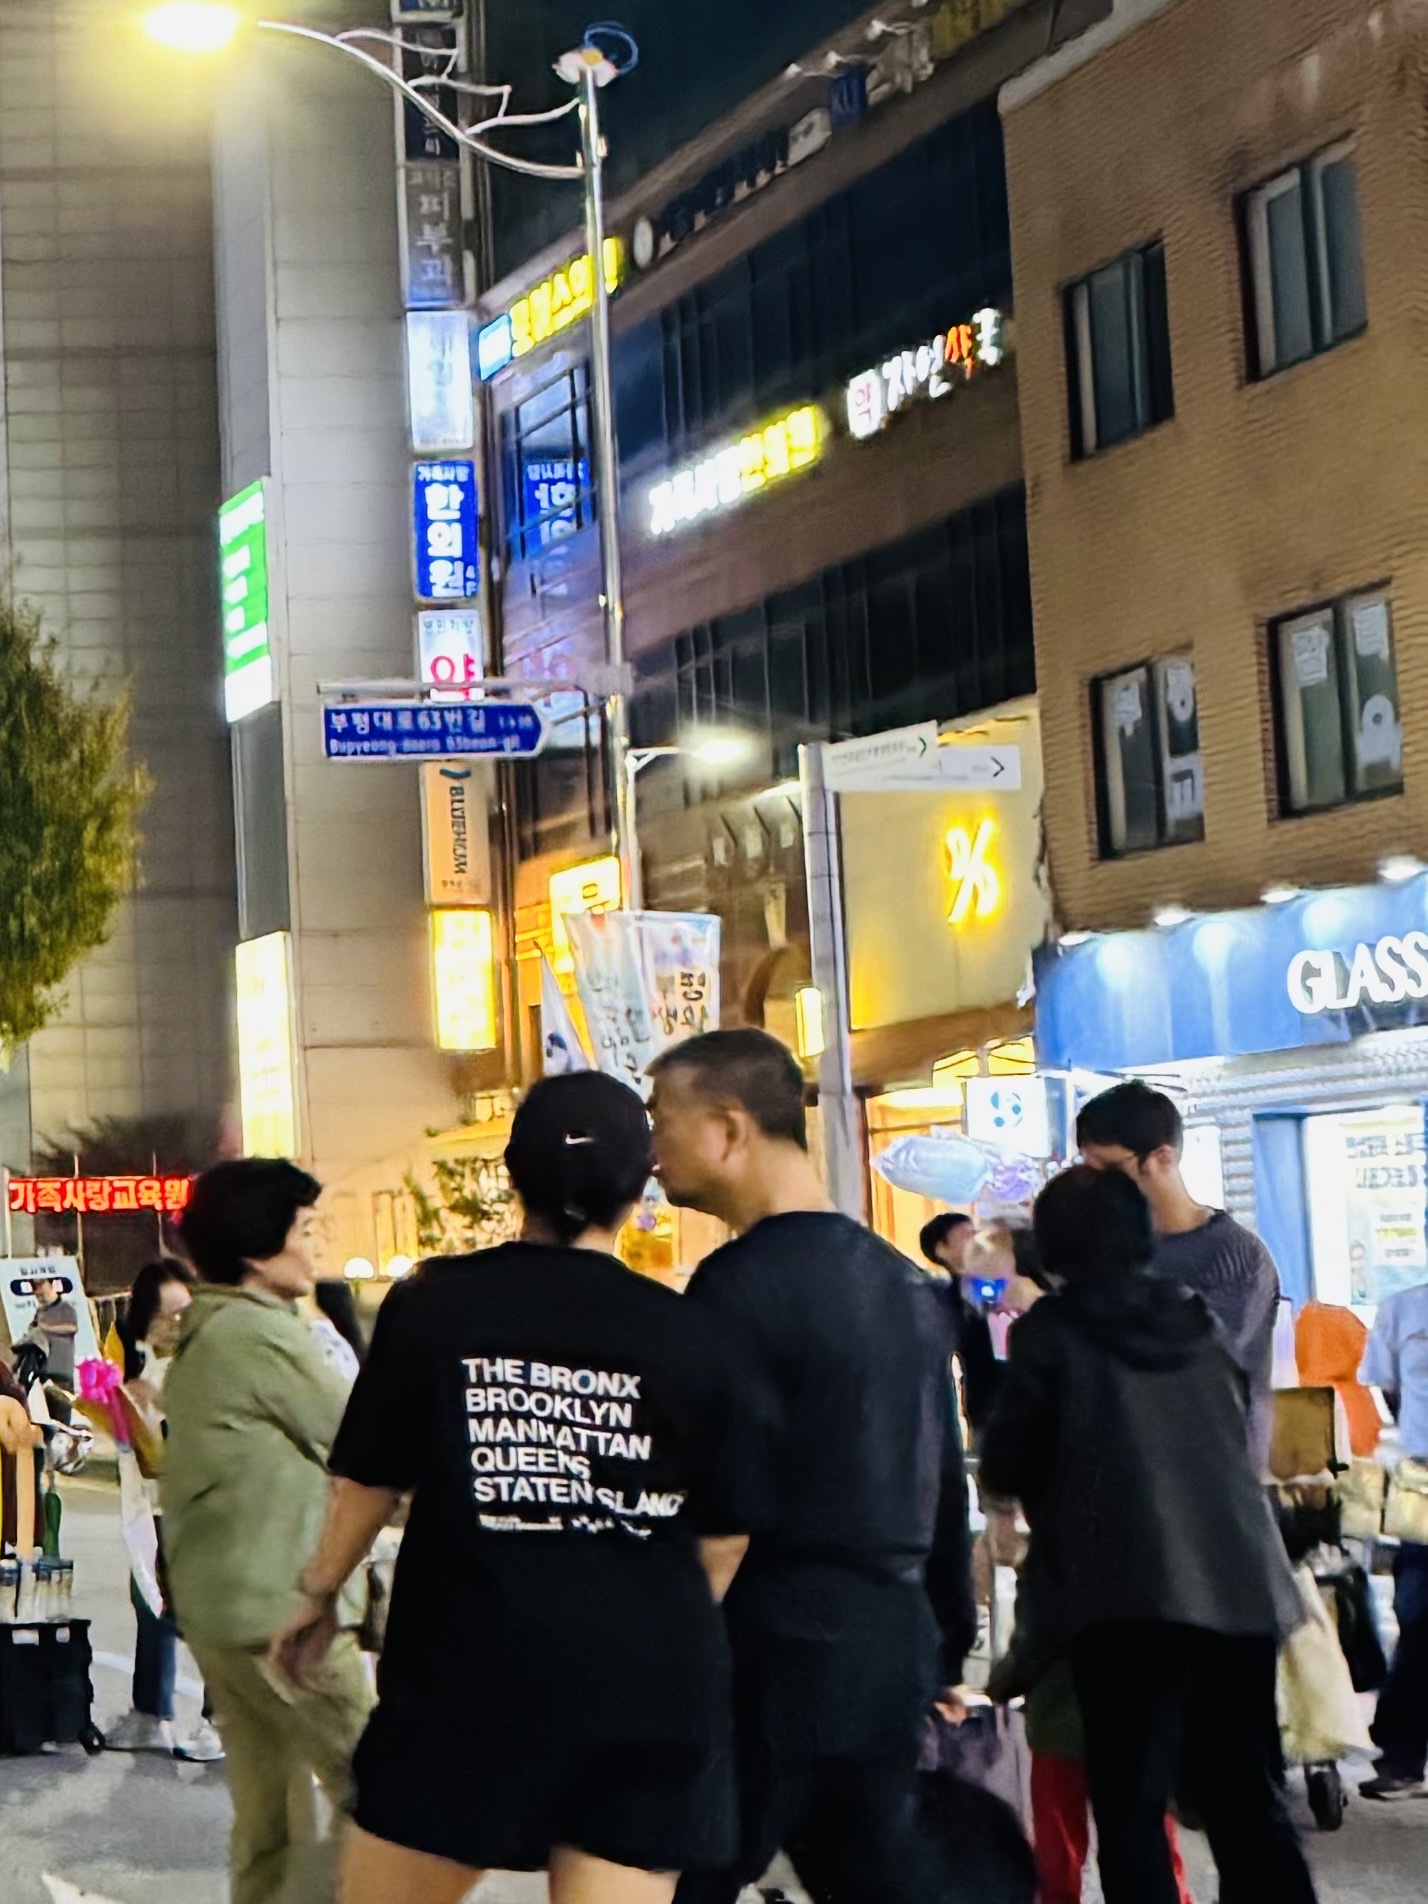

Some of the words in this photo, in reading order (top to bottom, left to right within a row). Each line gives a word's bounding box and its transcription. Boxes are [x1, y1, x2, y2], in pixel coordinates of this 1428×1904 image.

[424, 483, 466, 597] 한의원
[1287, 931, 1428, 1014] GLASS
[8, 1179, 189, 1213] 가족사랑교육원
[461, 1357, 524, 1384] THE
[530, 1361, 641, 1400] BRONX
[465, 1387, 633, 1428] BROOKLYN
[468, 1418, 652, 1460] MANHATTAN
[471, 1446, 592, 1480] QUEENS
[473, 1476, 593, 1505] STATEN
